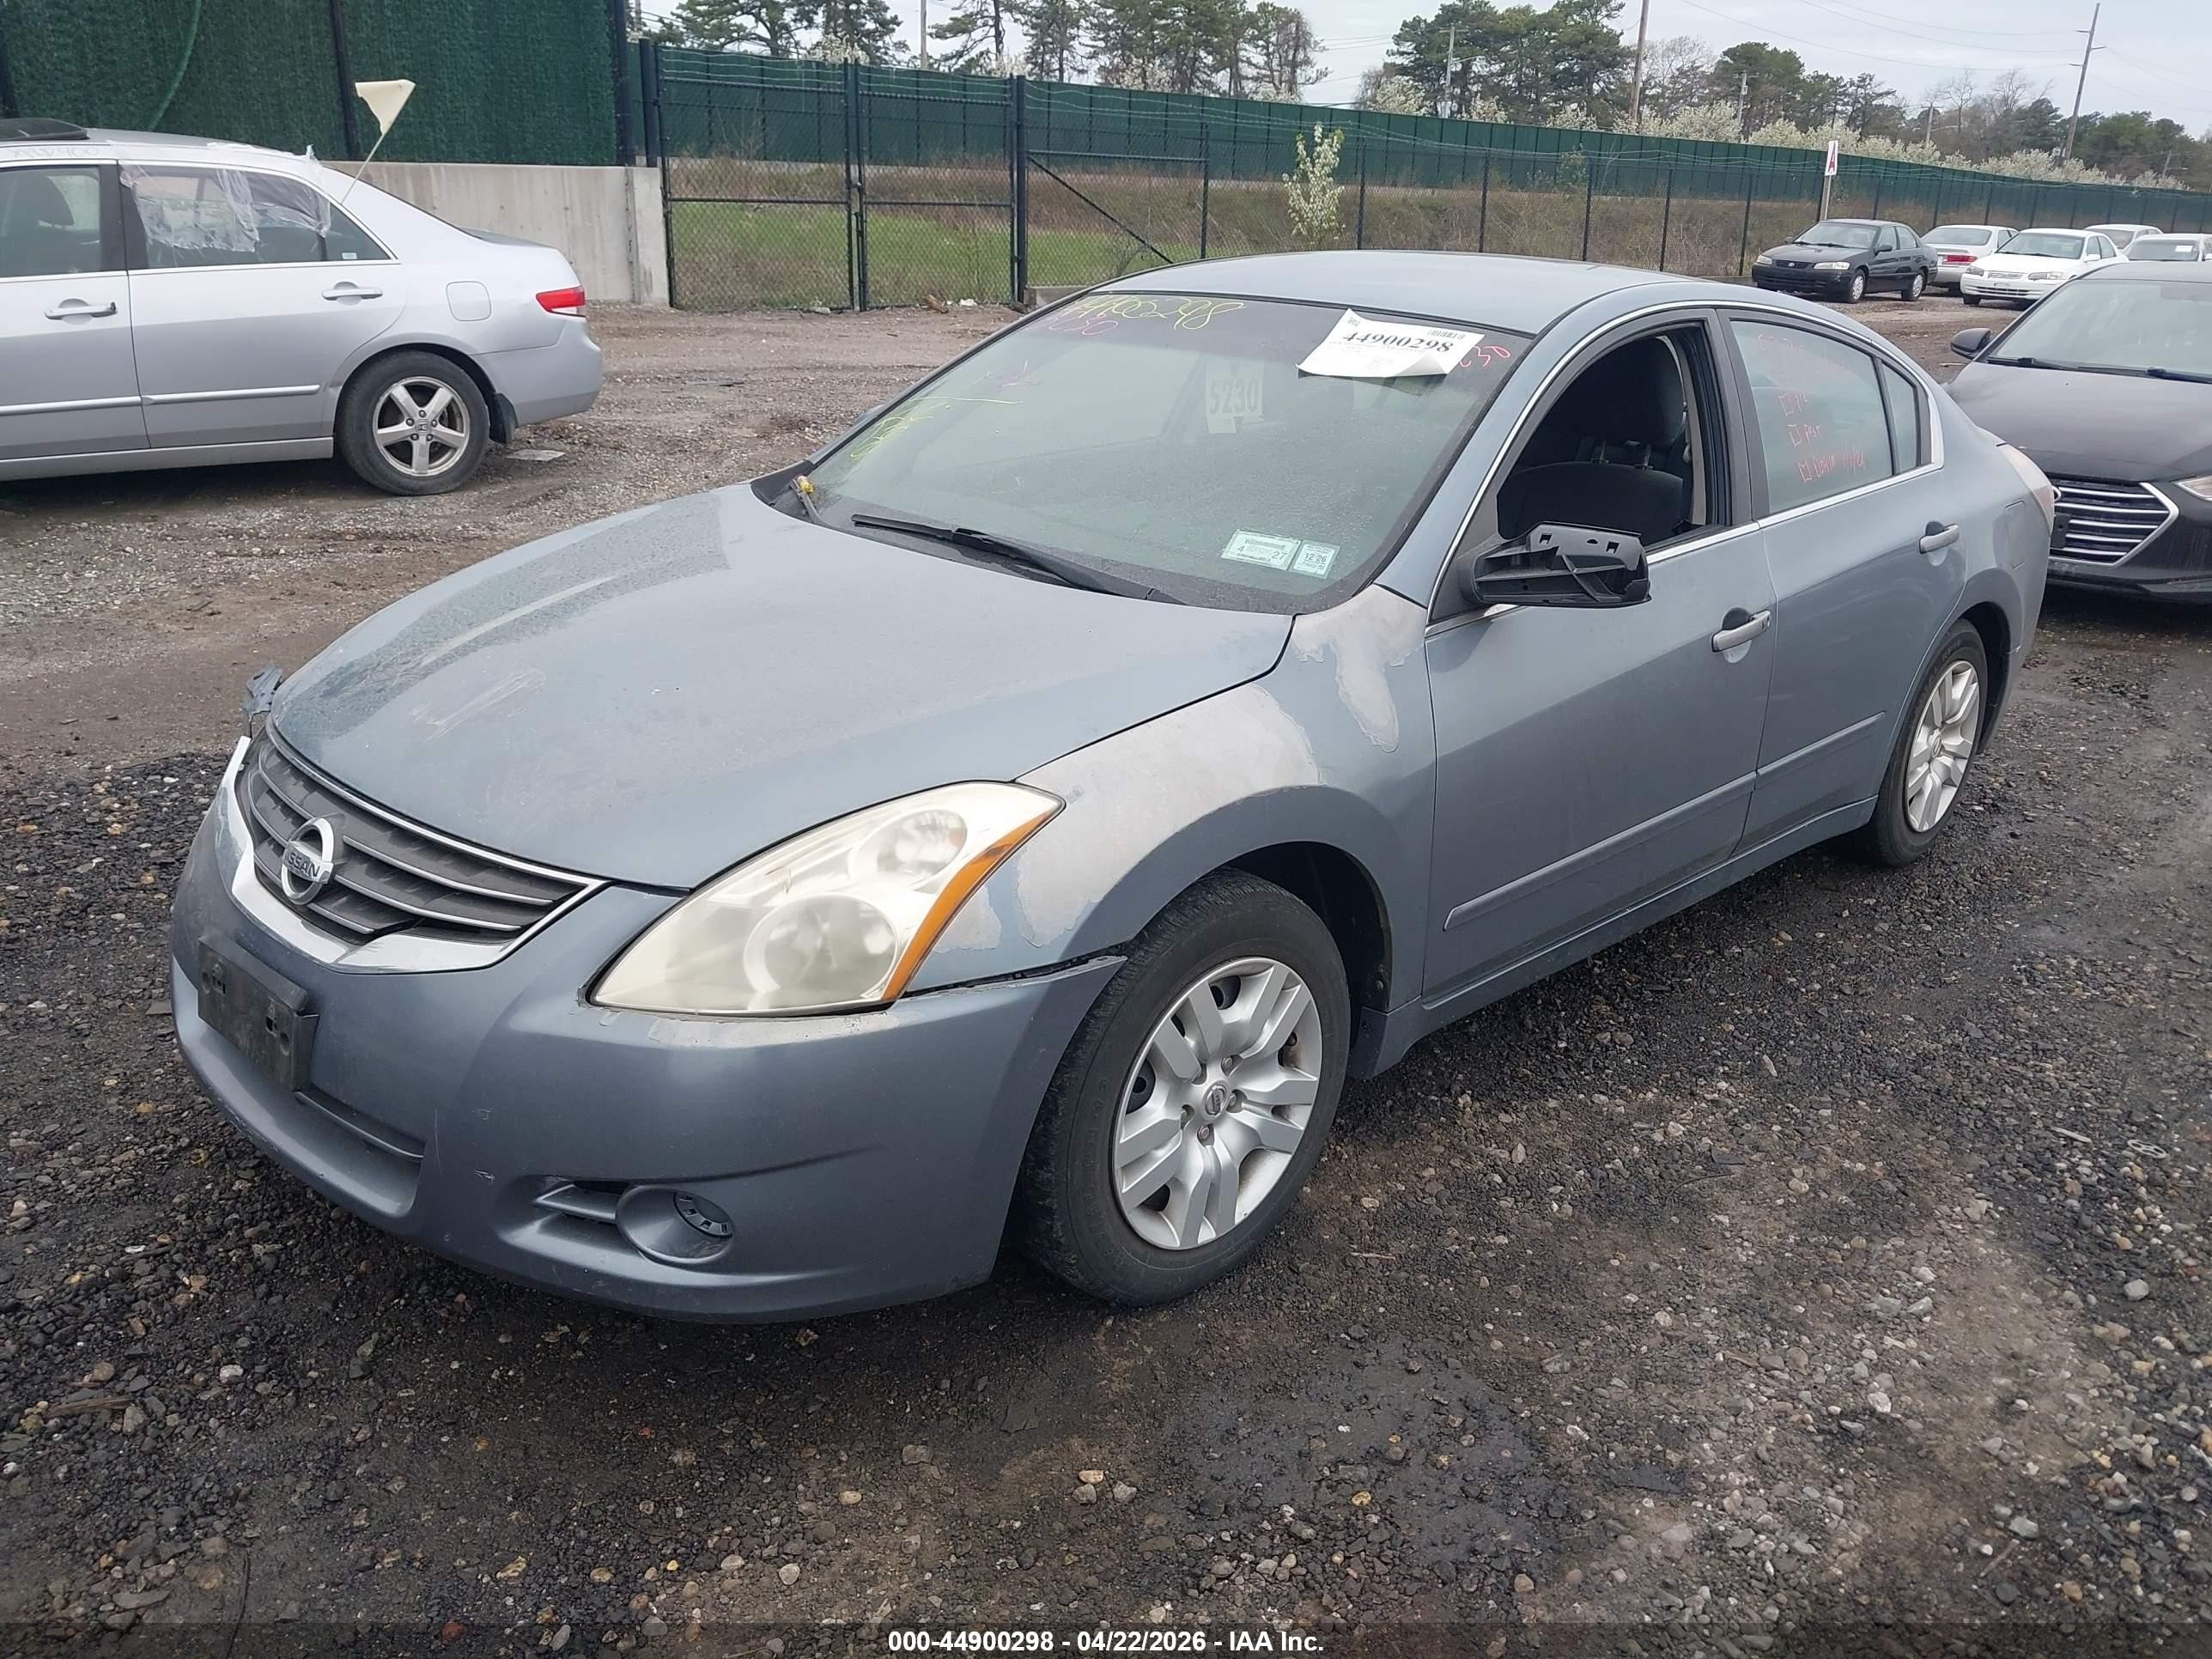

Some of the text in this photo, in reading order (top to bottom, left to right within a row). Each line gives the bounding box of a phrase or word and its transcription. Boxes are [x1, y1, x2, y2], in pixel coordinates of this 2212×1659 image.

[1340, 331, 1455, 354] 44900298
[1209, 378, 1260, 414] 5230
[1271, 550, 1289, 561] 27
[1304, 552, 1328, 563] 12 26
[285, 850, 321, 878] SSAN
